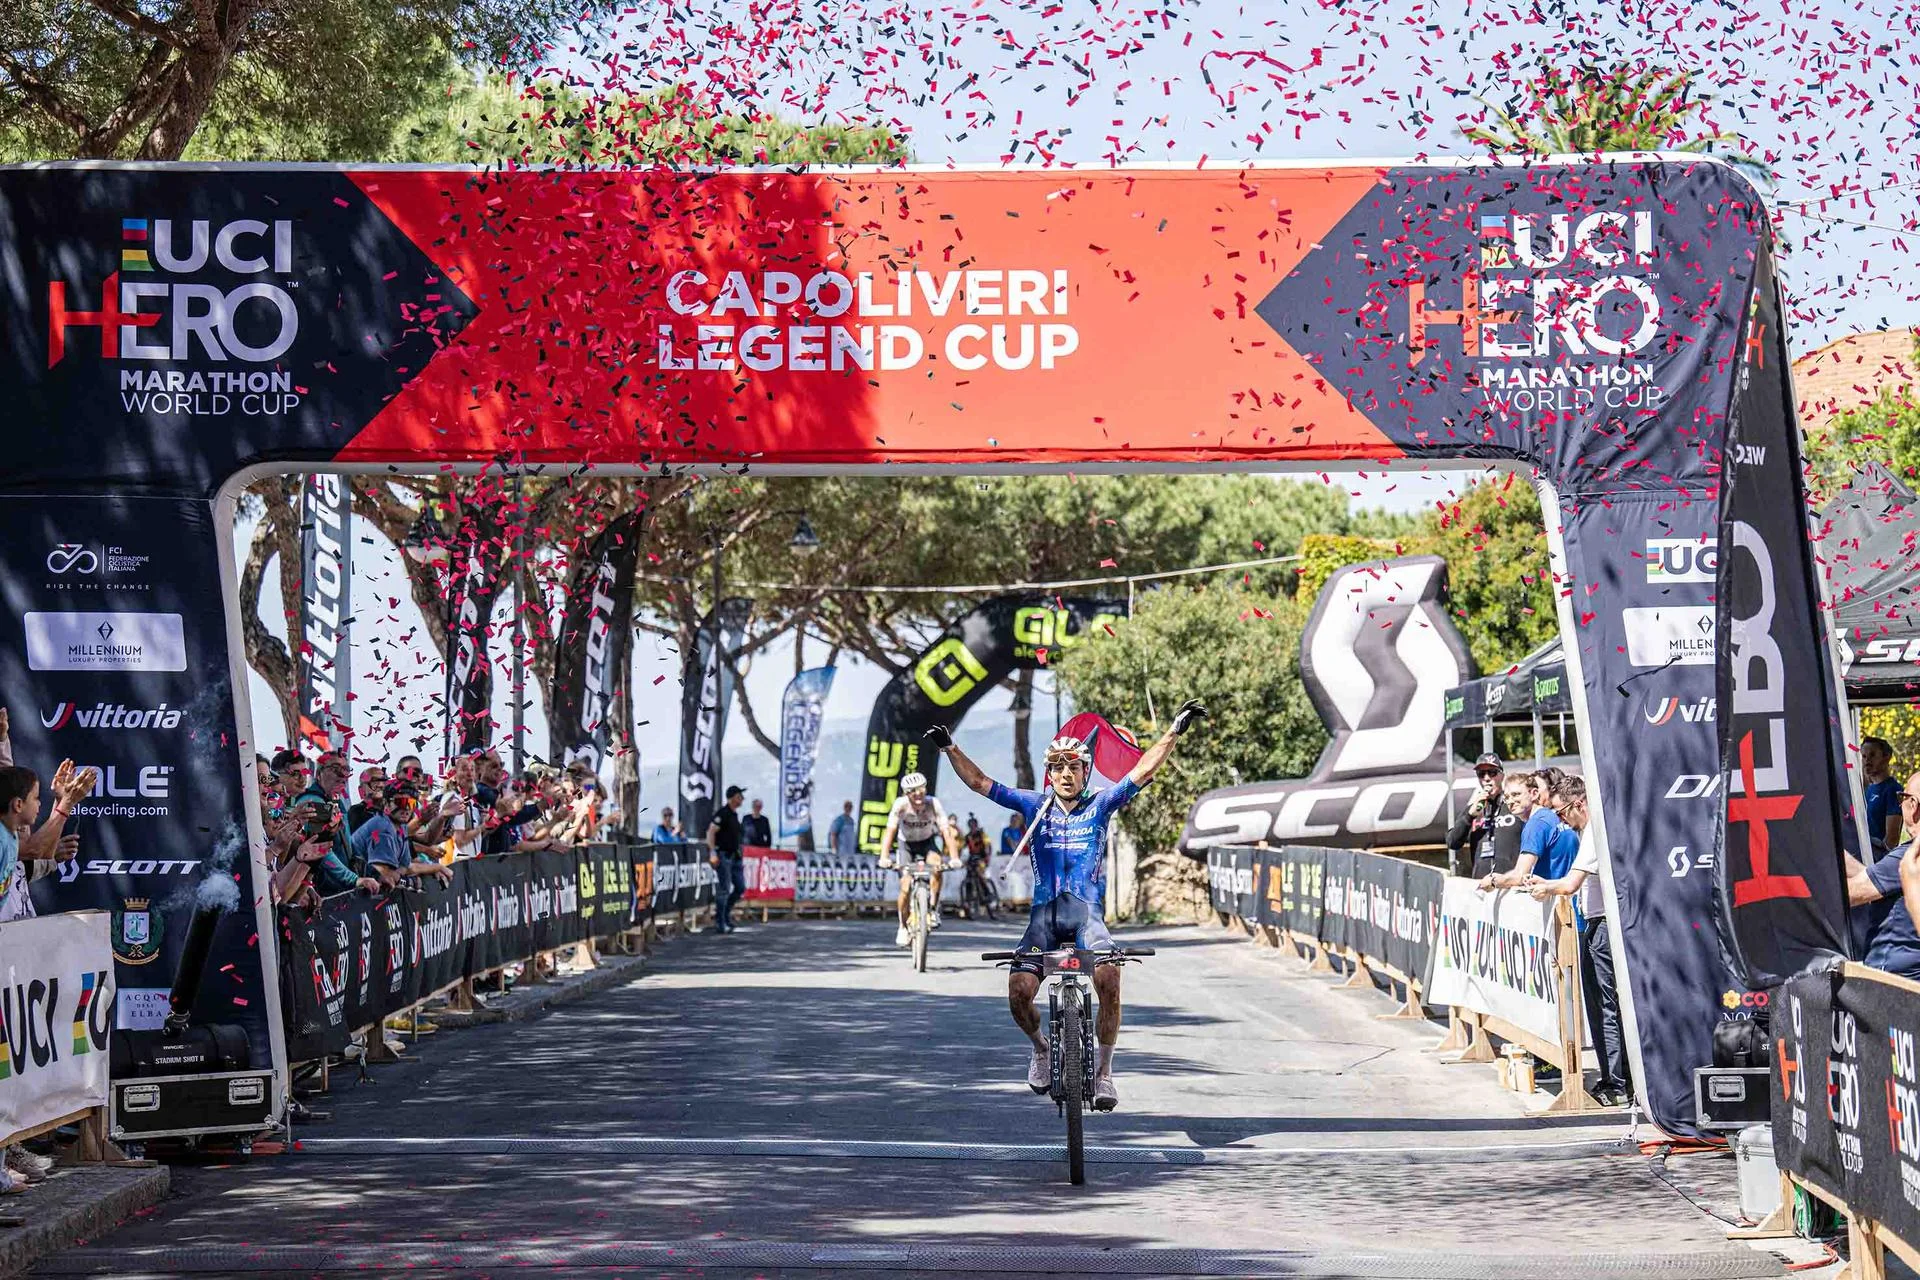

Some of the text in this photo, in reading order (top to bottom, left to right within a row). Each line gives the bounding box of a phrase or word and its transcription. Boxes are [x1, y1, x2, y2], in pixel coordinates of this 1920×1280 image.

[154, 218, 292, 274] UCI
[1513, 210, 1654, 270] UCI
[665, 269, 1069, 318] CAPOLIVERI
[48, 270, 299, 369] HERO
[1408, 270, 1661, 368] HERO
[658, 323, 1080, 372] LEGEND CUP
[120, 370, 291, 392] MARATHON
[1483, 363, 1654, 389] MARATHON
[122, 392, 300, 416] WORLD CUP
[1483, 384, 1663, 412] WORLD CUP
[108, 546, 123, 555] FCI
[108, 555, 150, 563] FEDERAZIONE
[106, 583, 151, 591] CHANGE
[68, 645, 142, 656] MILLENNIUM
[1669, 639, 1716, 651] MILLEN
[75, 702, 182, 729] vittoria
[69, 803, 169, 818] alecycling.com
[1186, 778, 1479, 849] SCO
[1055, 826, 1094, 837] KENDA
[82, 859, 202, 875] SCOTT
[419, 901, 453, 959] vittoria
[1503, 927, 1527, 994] UCI
[125, 993, 169, 1003] ACQUA
[131, 1010, 163, 1018] ELBA
[155, 1056, 182, 1065] STADIUM
[182, 1055, 199, 1063] SHOT
[1051, 1032, 1059, 1081] MANITOU
[1086, 1032, 1094, 1081] MANITOU
[1894, 1025, 1916, 1084] UCI
